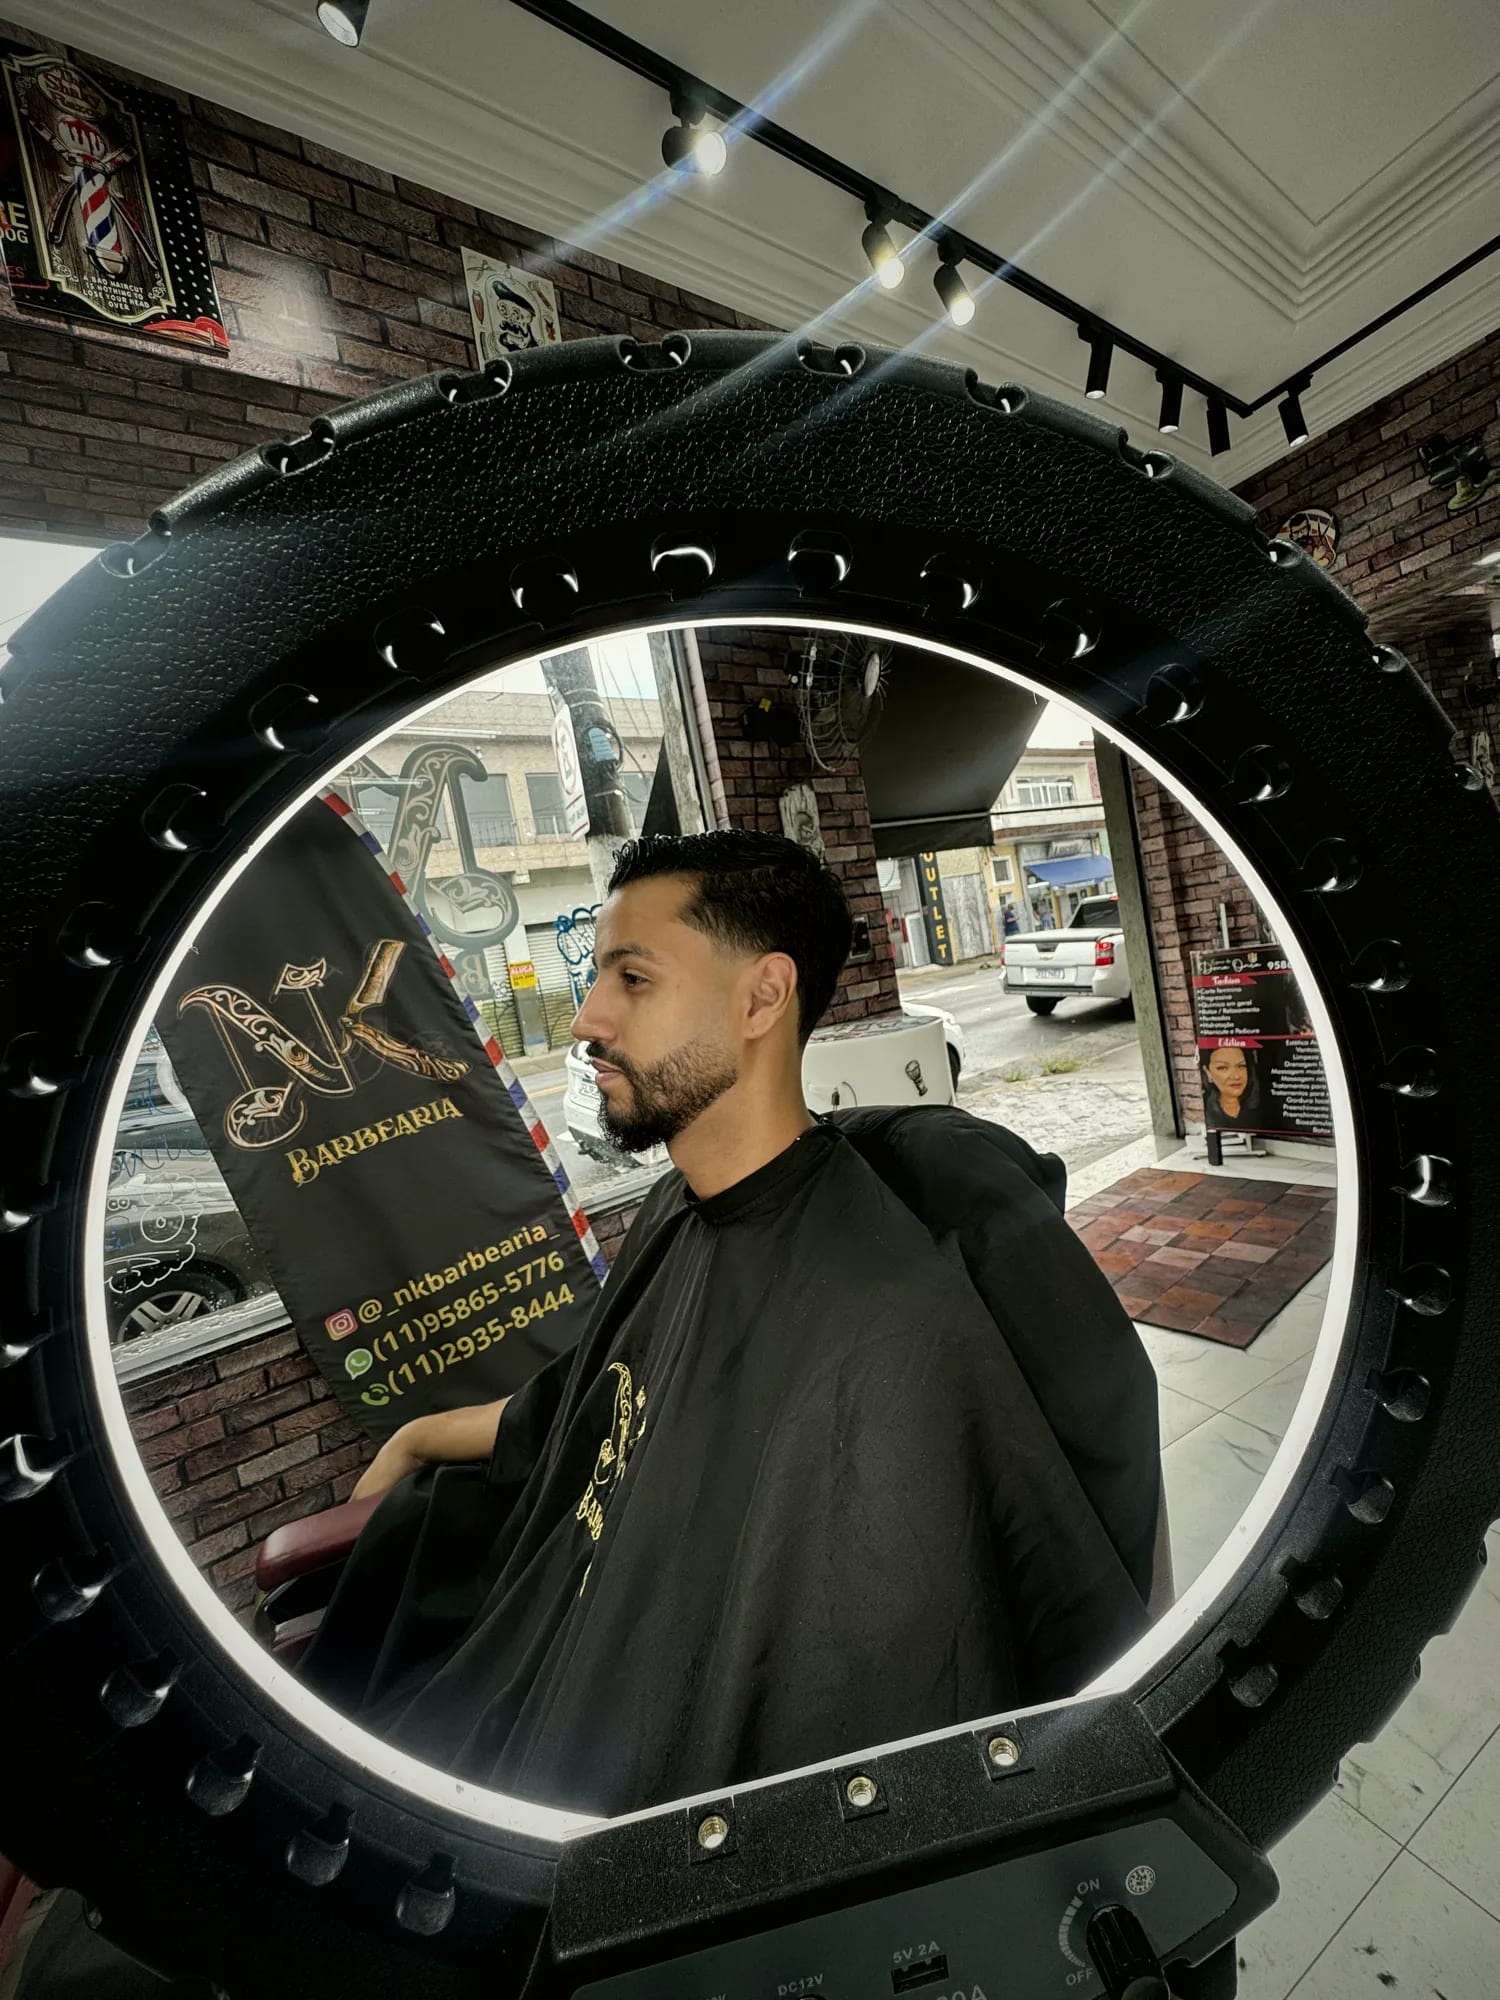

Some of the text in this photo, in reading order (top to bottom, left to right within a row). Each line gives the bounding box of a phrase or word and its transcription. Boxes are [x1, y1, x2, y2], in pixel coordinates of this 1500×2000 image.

[91, 276, 108, 285] BAD
[110, 281, 143, 293] HAIRCUT
[97, 285, 132, 297] NOTHING
[134, 292, 144, 300] TO
[105, 293, 127, 303] YOUR
[129, 298, 150, 308] HEAD
[108, 301, 130, 311] OVER
[358, 1224, 561, 1324] @_nkbarbearia_
[373, 1251, 565, 1362] (11)95865-5776
[387, 1283, 575, 1396] (11)2935-8444
[1077, 1877, 1100, 1895] ON
[892, 1940, 940, 1964] 5V 2A
[777, 1973, 824, 1996] DC12V
[1065, 1968, 1095, 1986] OFF
